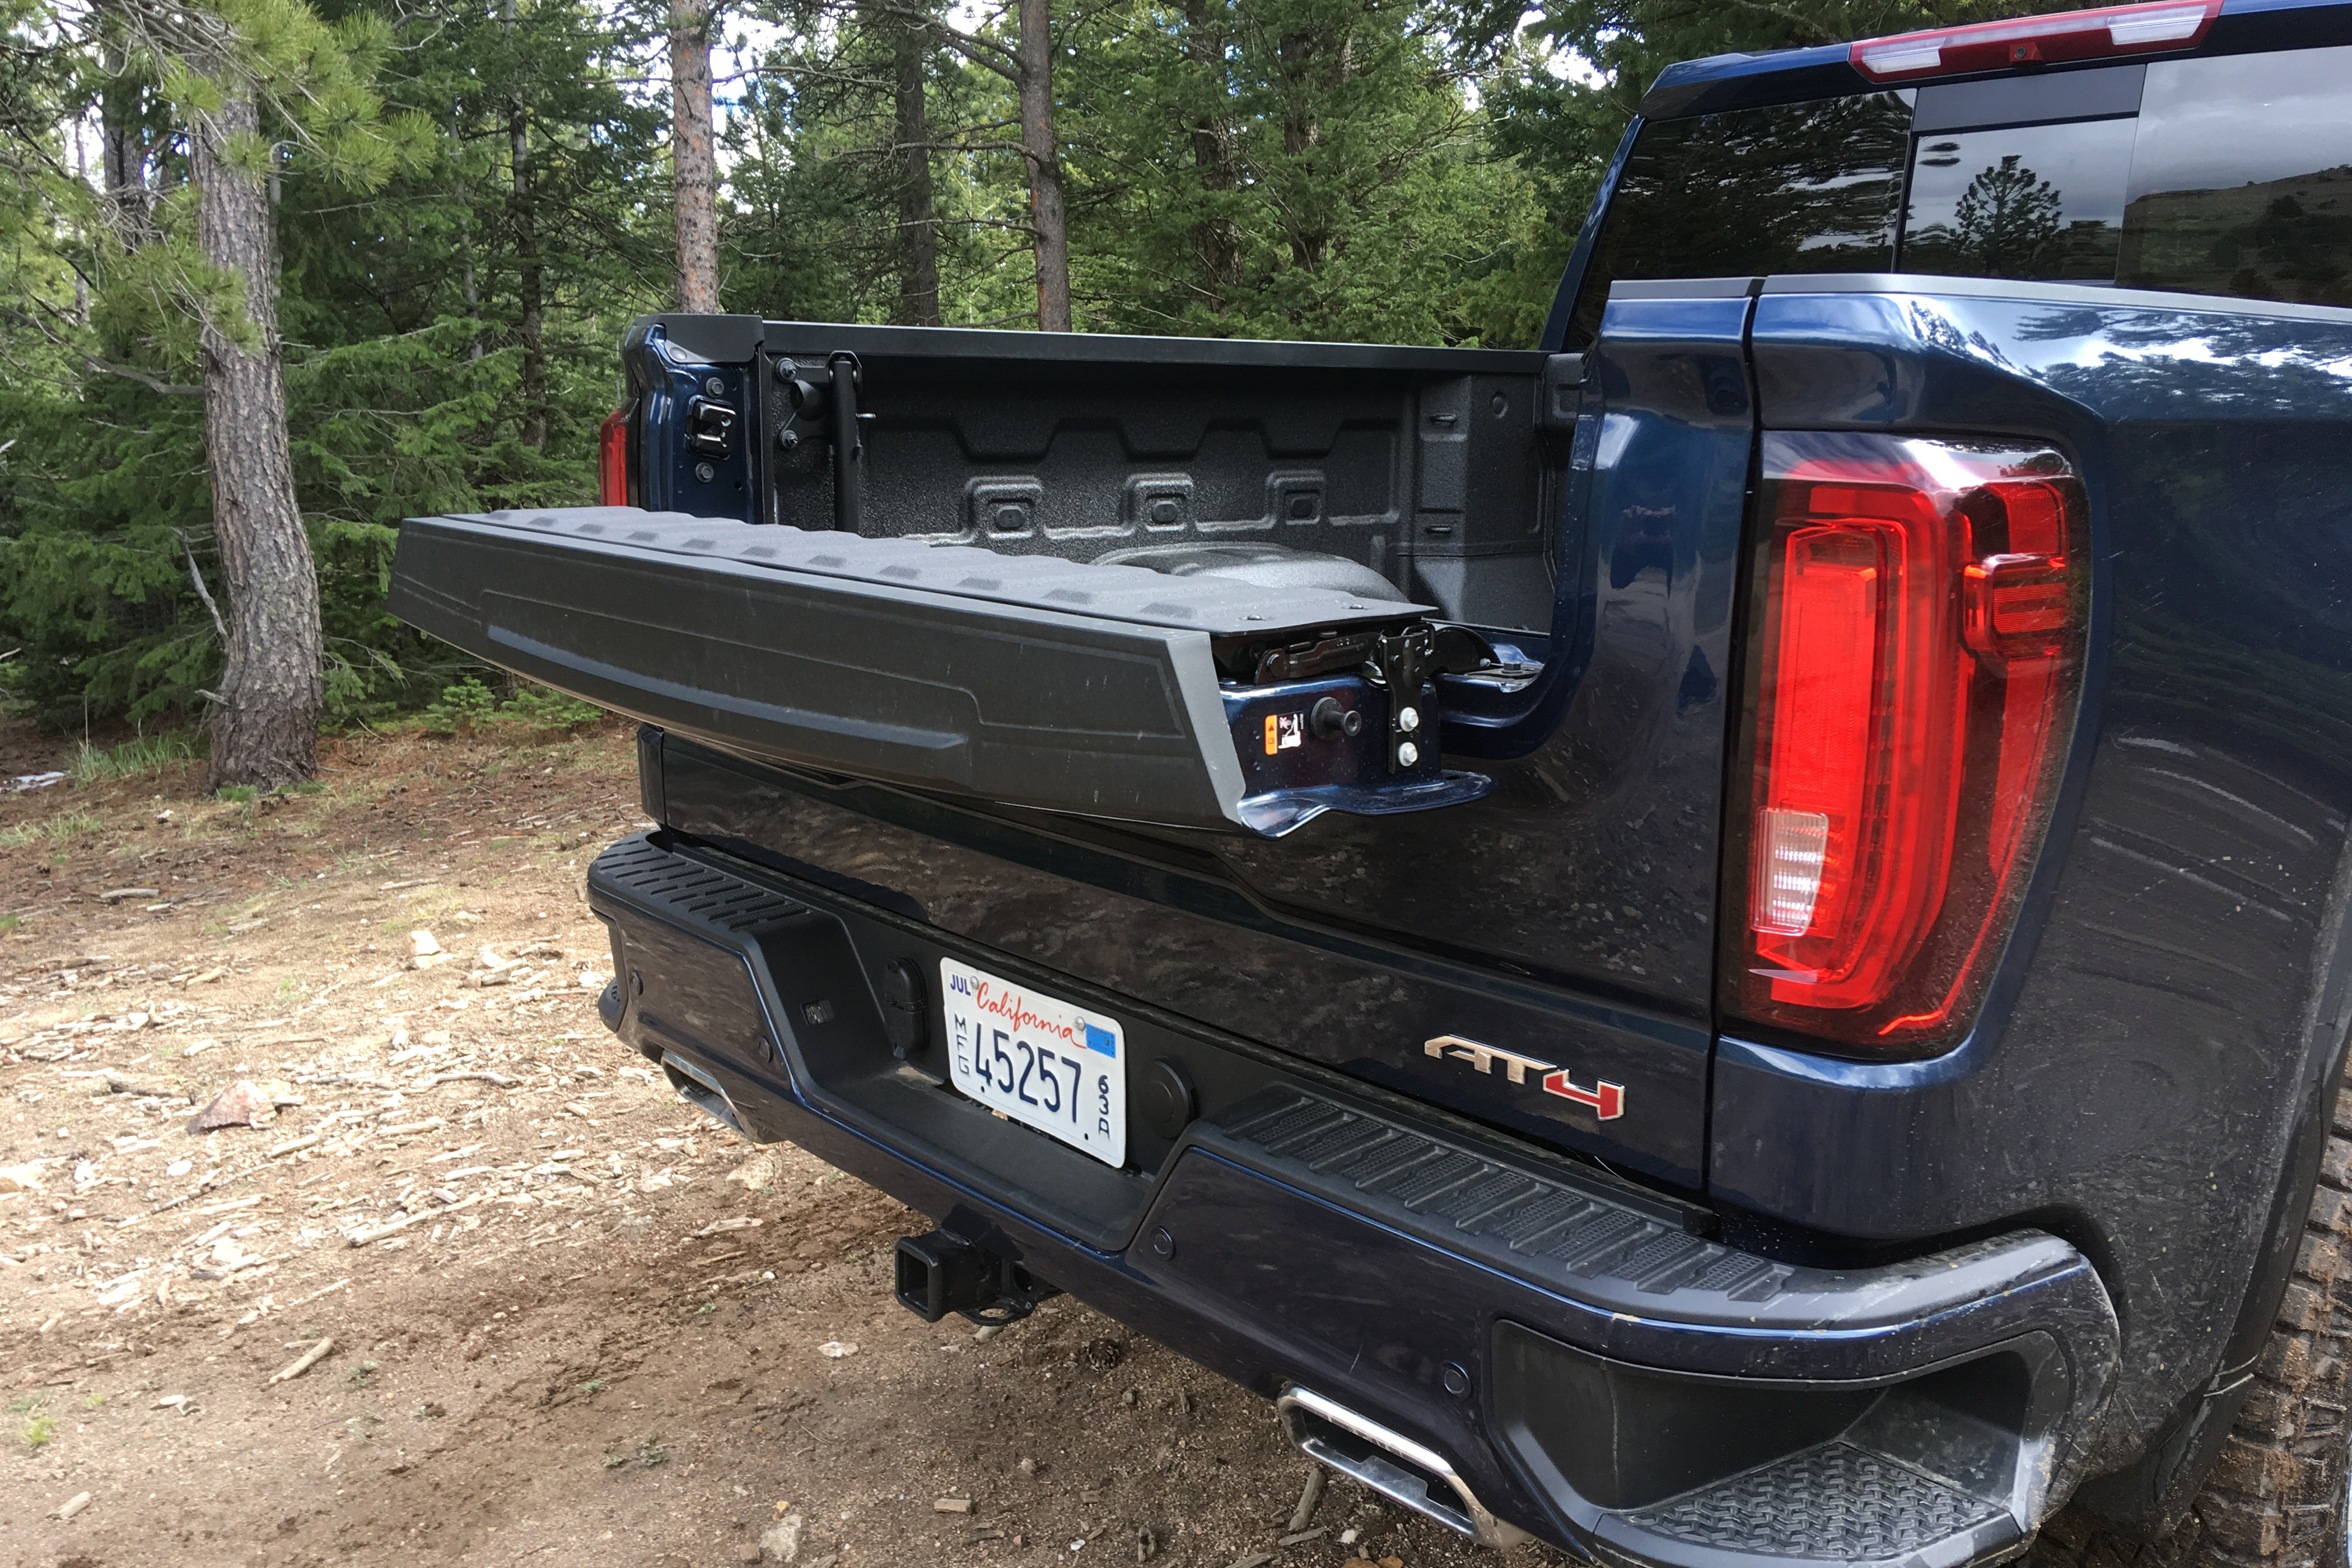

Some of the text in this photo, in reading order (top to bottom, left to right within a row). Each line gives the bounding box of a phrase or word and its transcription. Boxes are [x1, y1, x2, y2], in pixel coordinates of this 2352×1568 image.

[950, 974, 971, 996] JUL
[977, 982, 1087, 1049] California
[954, 1013, 970, 1076] MFG
[975, 1022, 1082, 1124] 45257
[1424, 1034, 1625, 1122] AT4
